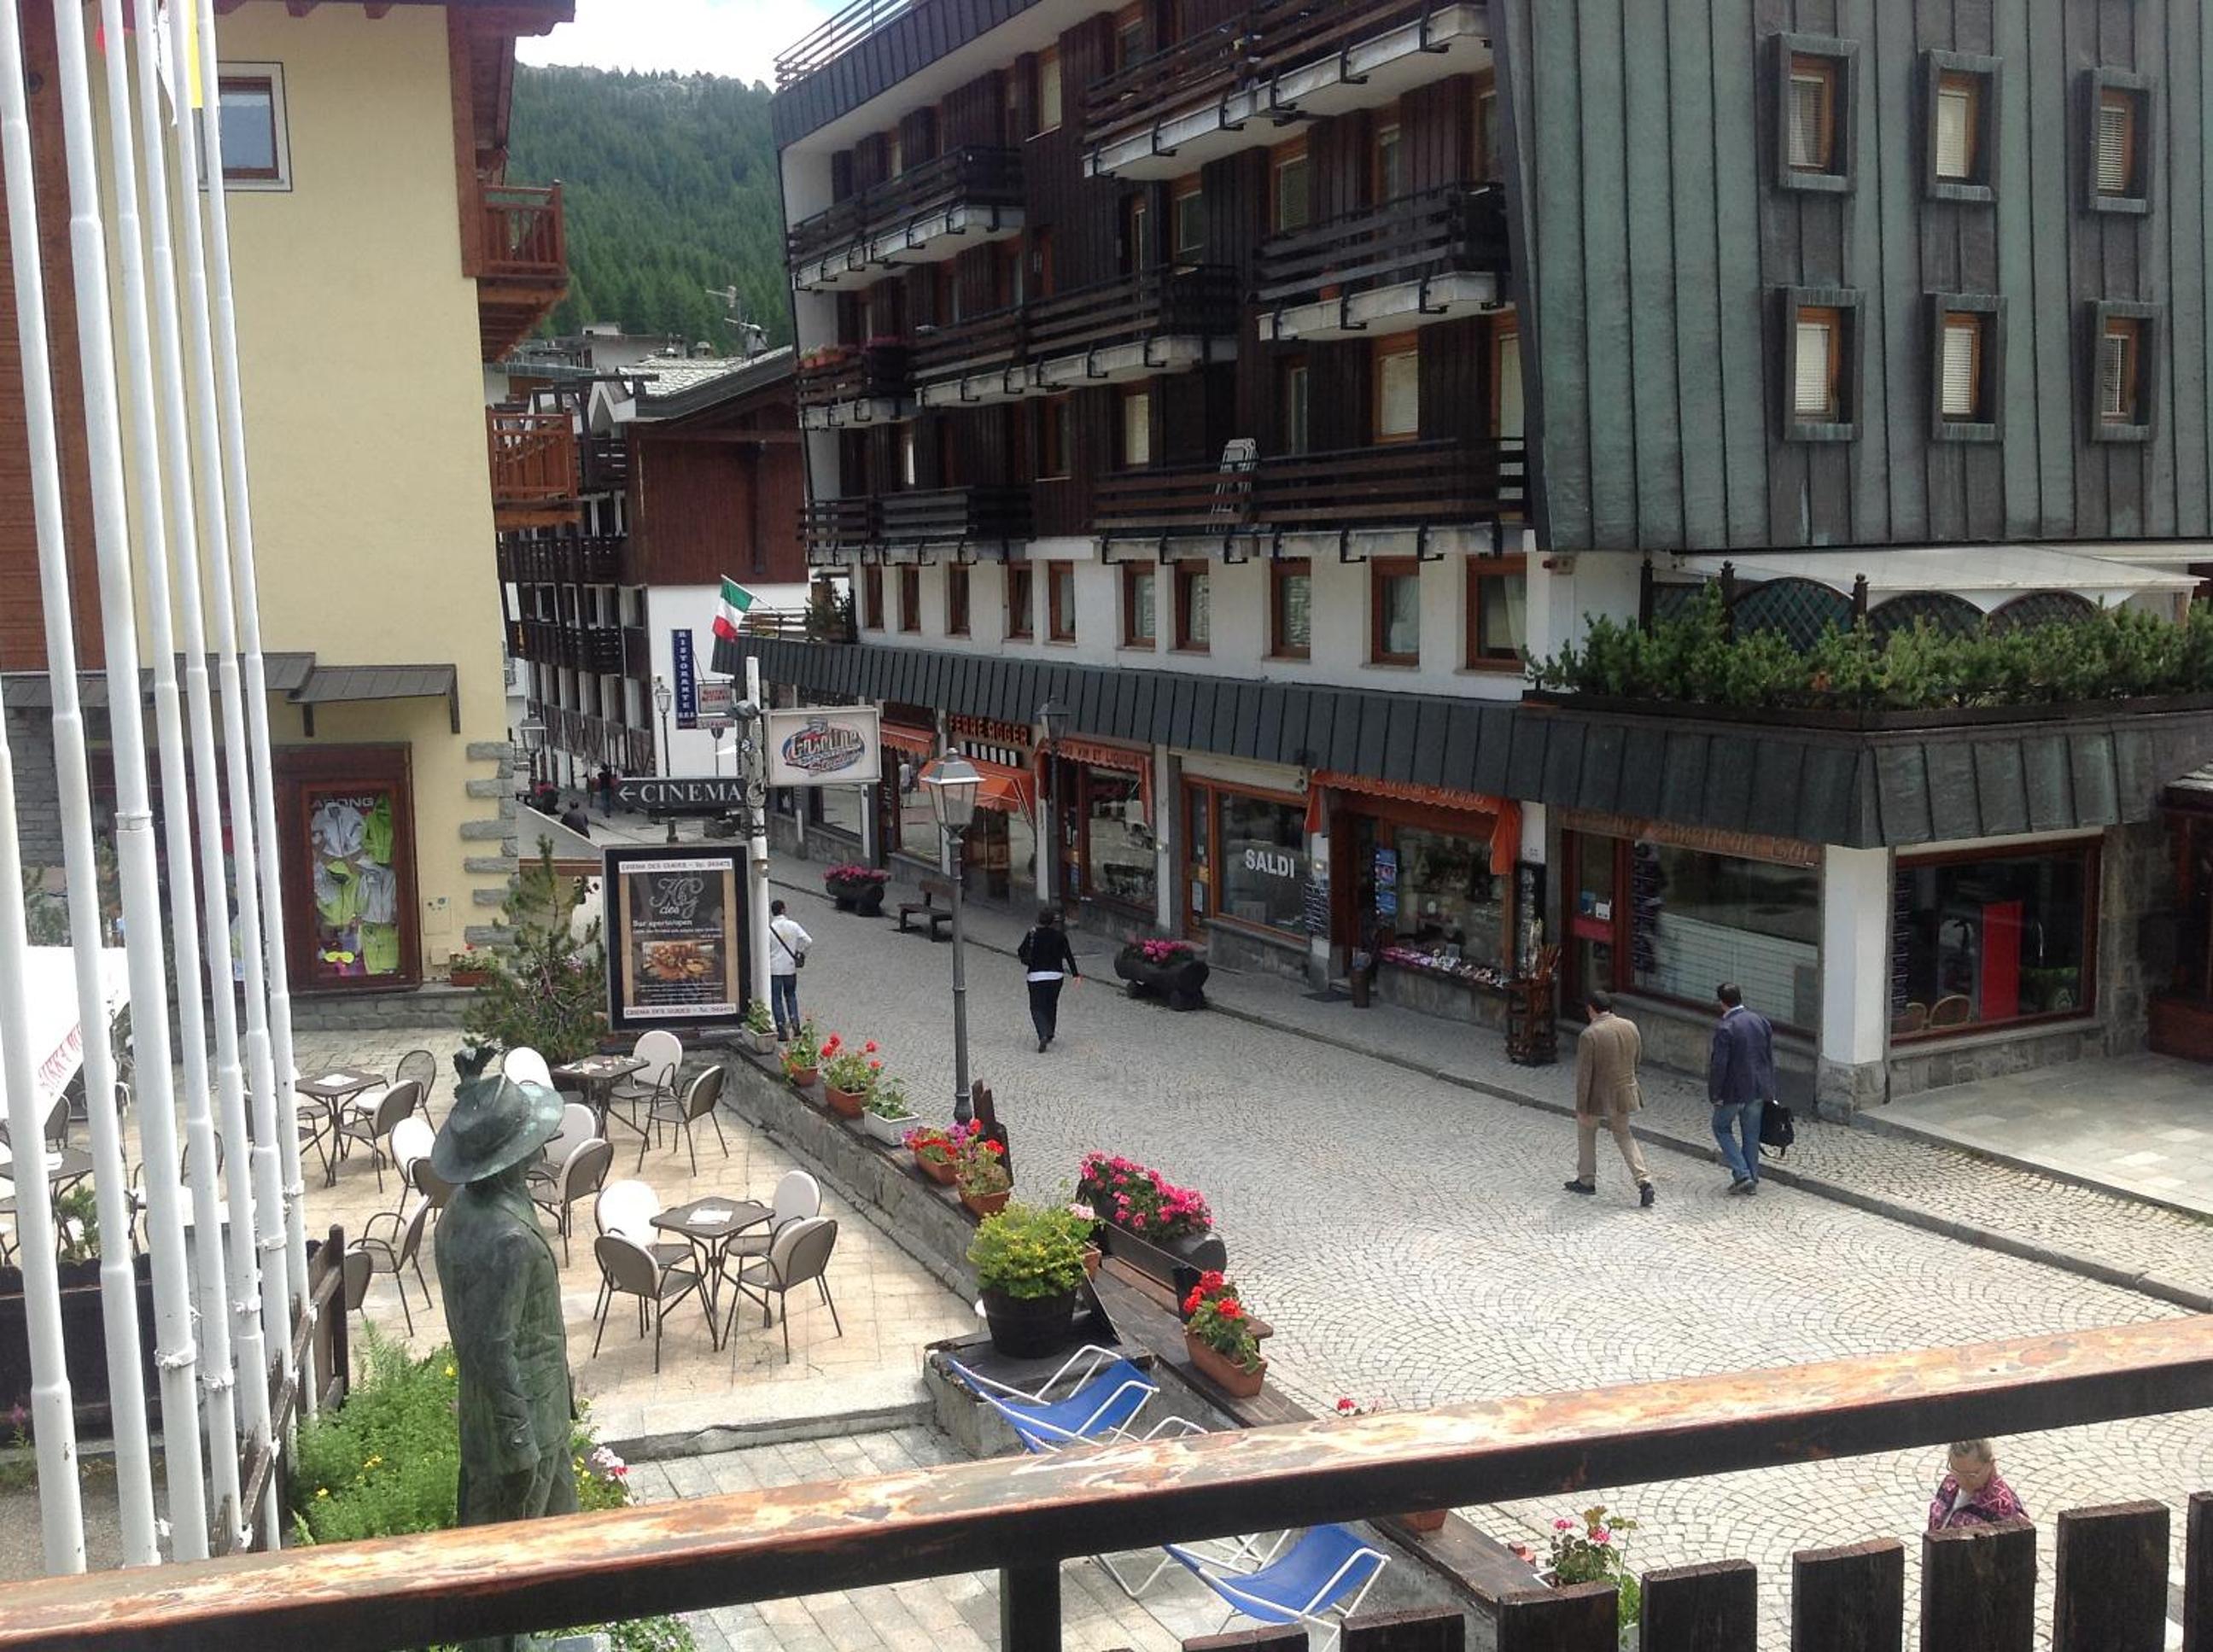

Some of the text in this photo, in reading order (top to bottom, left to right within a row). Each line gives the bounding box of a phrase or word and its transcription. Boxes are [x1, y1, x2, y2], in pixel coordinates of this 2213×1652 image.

[678, 631, 691, 709] RISTORANTE
[790, 727, 861, 758] Gasoline
[639, 783, 743, 803] CINEMA
[1245, 849, 1294, 879] SALDI
